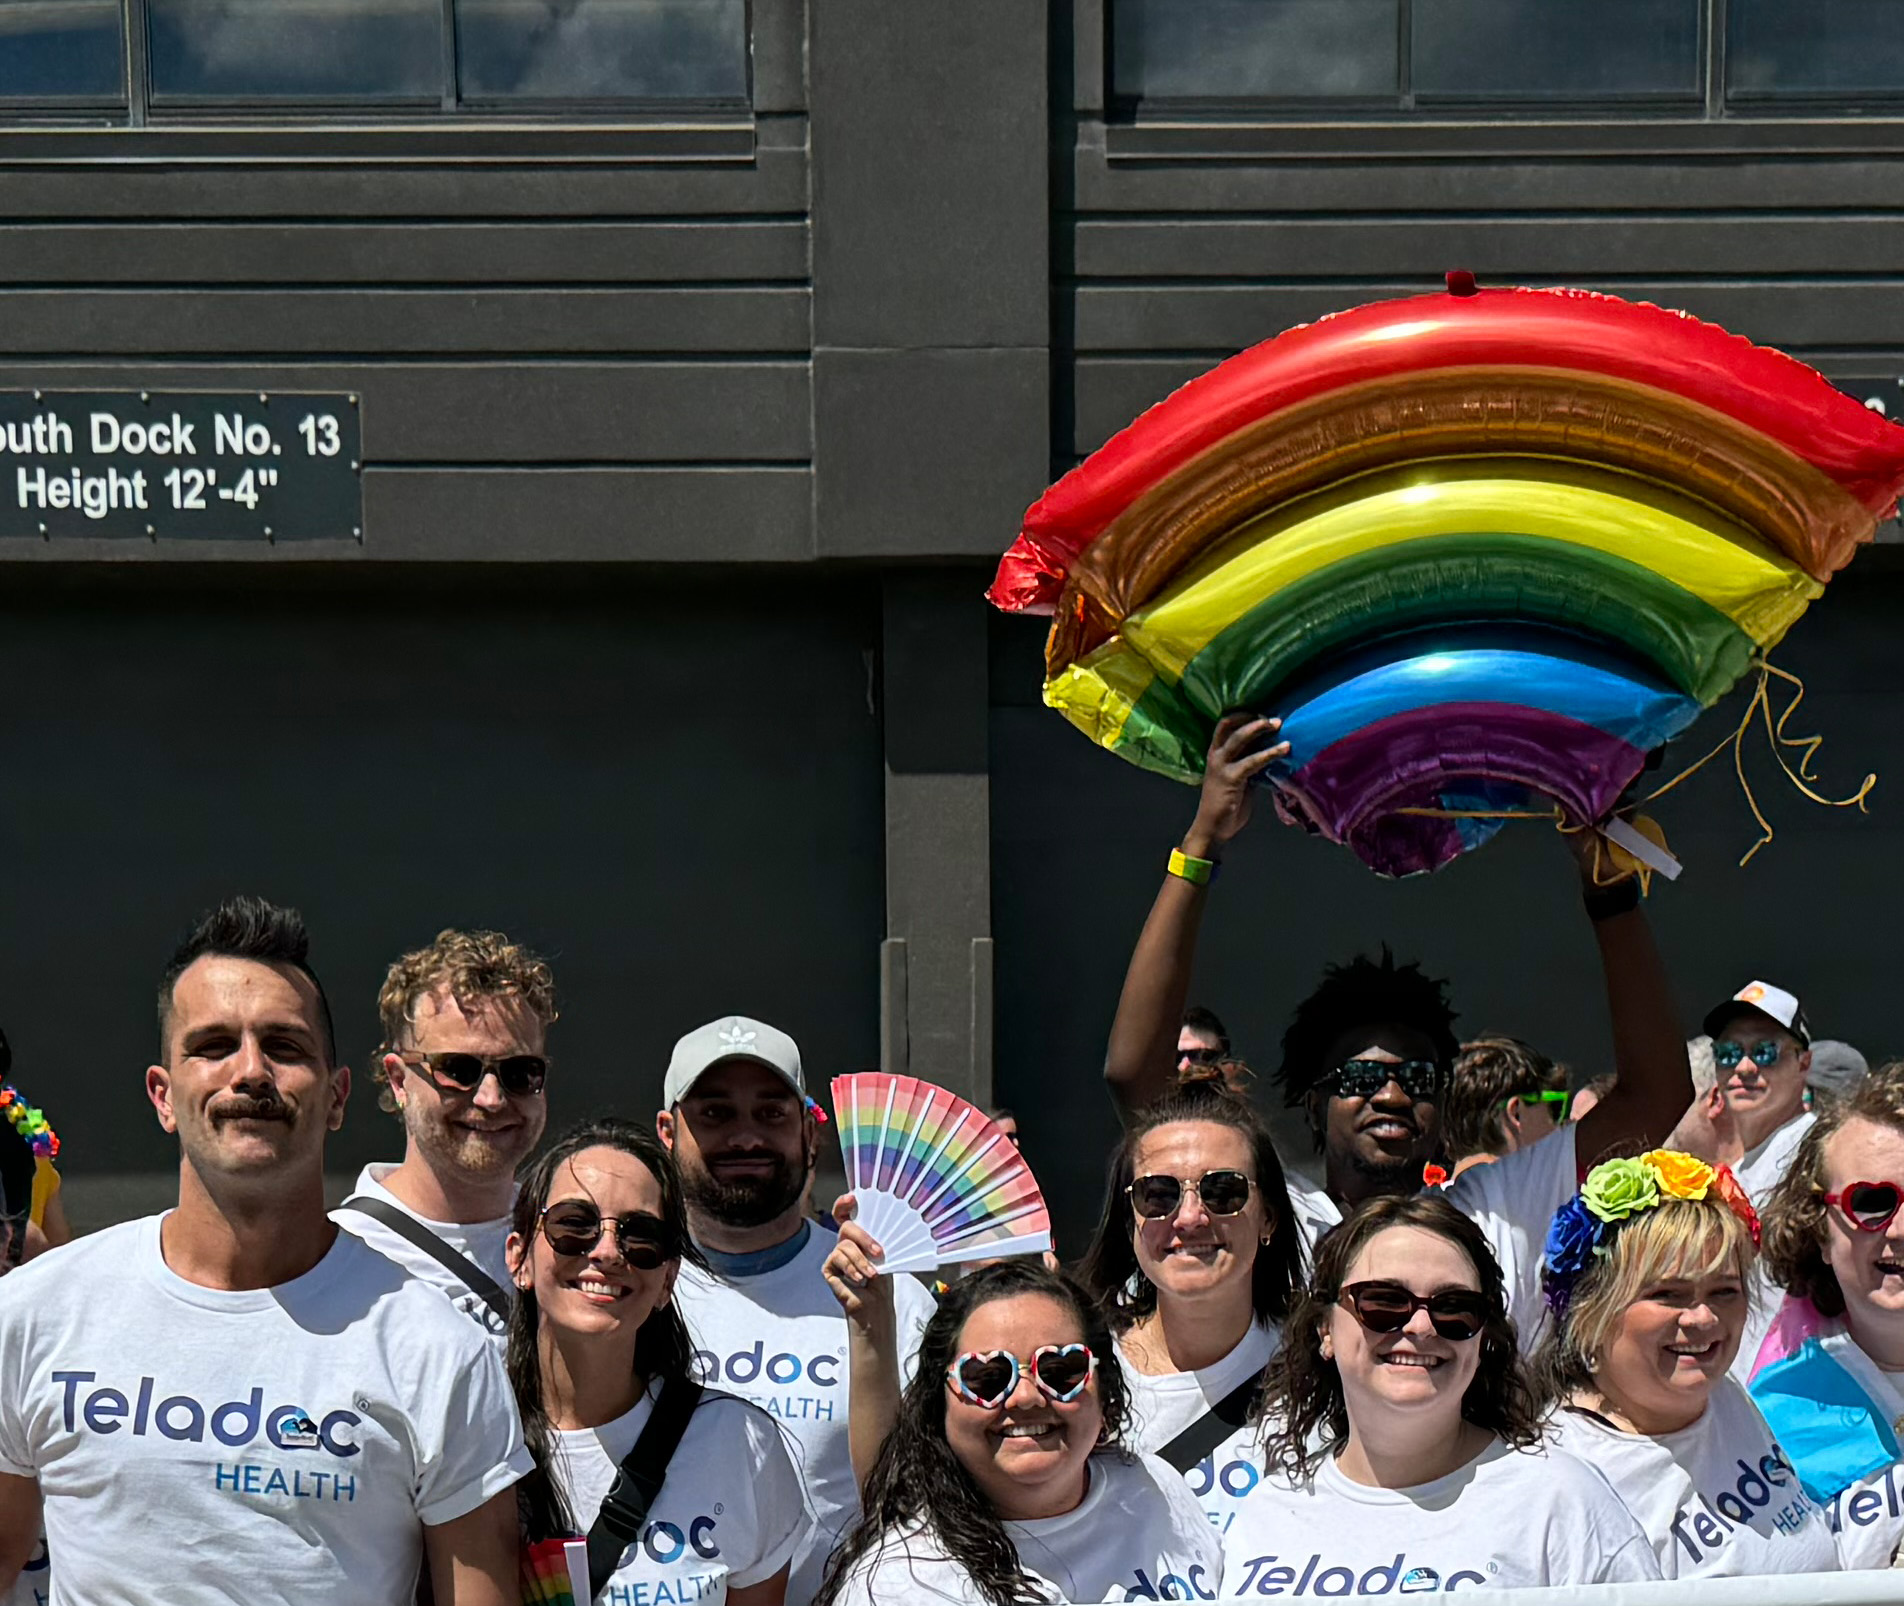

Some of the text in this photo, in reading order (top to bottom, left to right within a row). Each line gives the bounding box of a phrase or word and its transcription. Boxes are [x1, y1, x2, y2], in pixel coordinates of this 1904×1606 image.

[90, 413, 197, 456] Dock
[214, 414, 282, 456] No.
[298, 415, 342, 457] 13
[17, 467, 278, 519] Height 12'-4"
[686, 1340, 840, 1387] adoc
[215, 1462, 356, 1502] HEALTH
